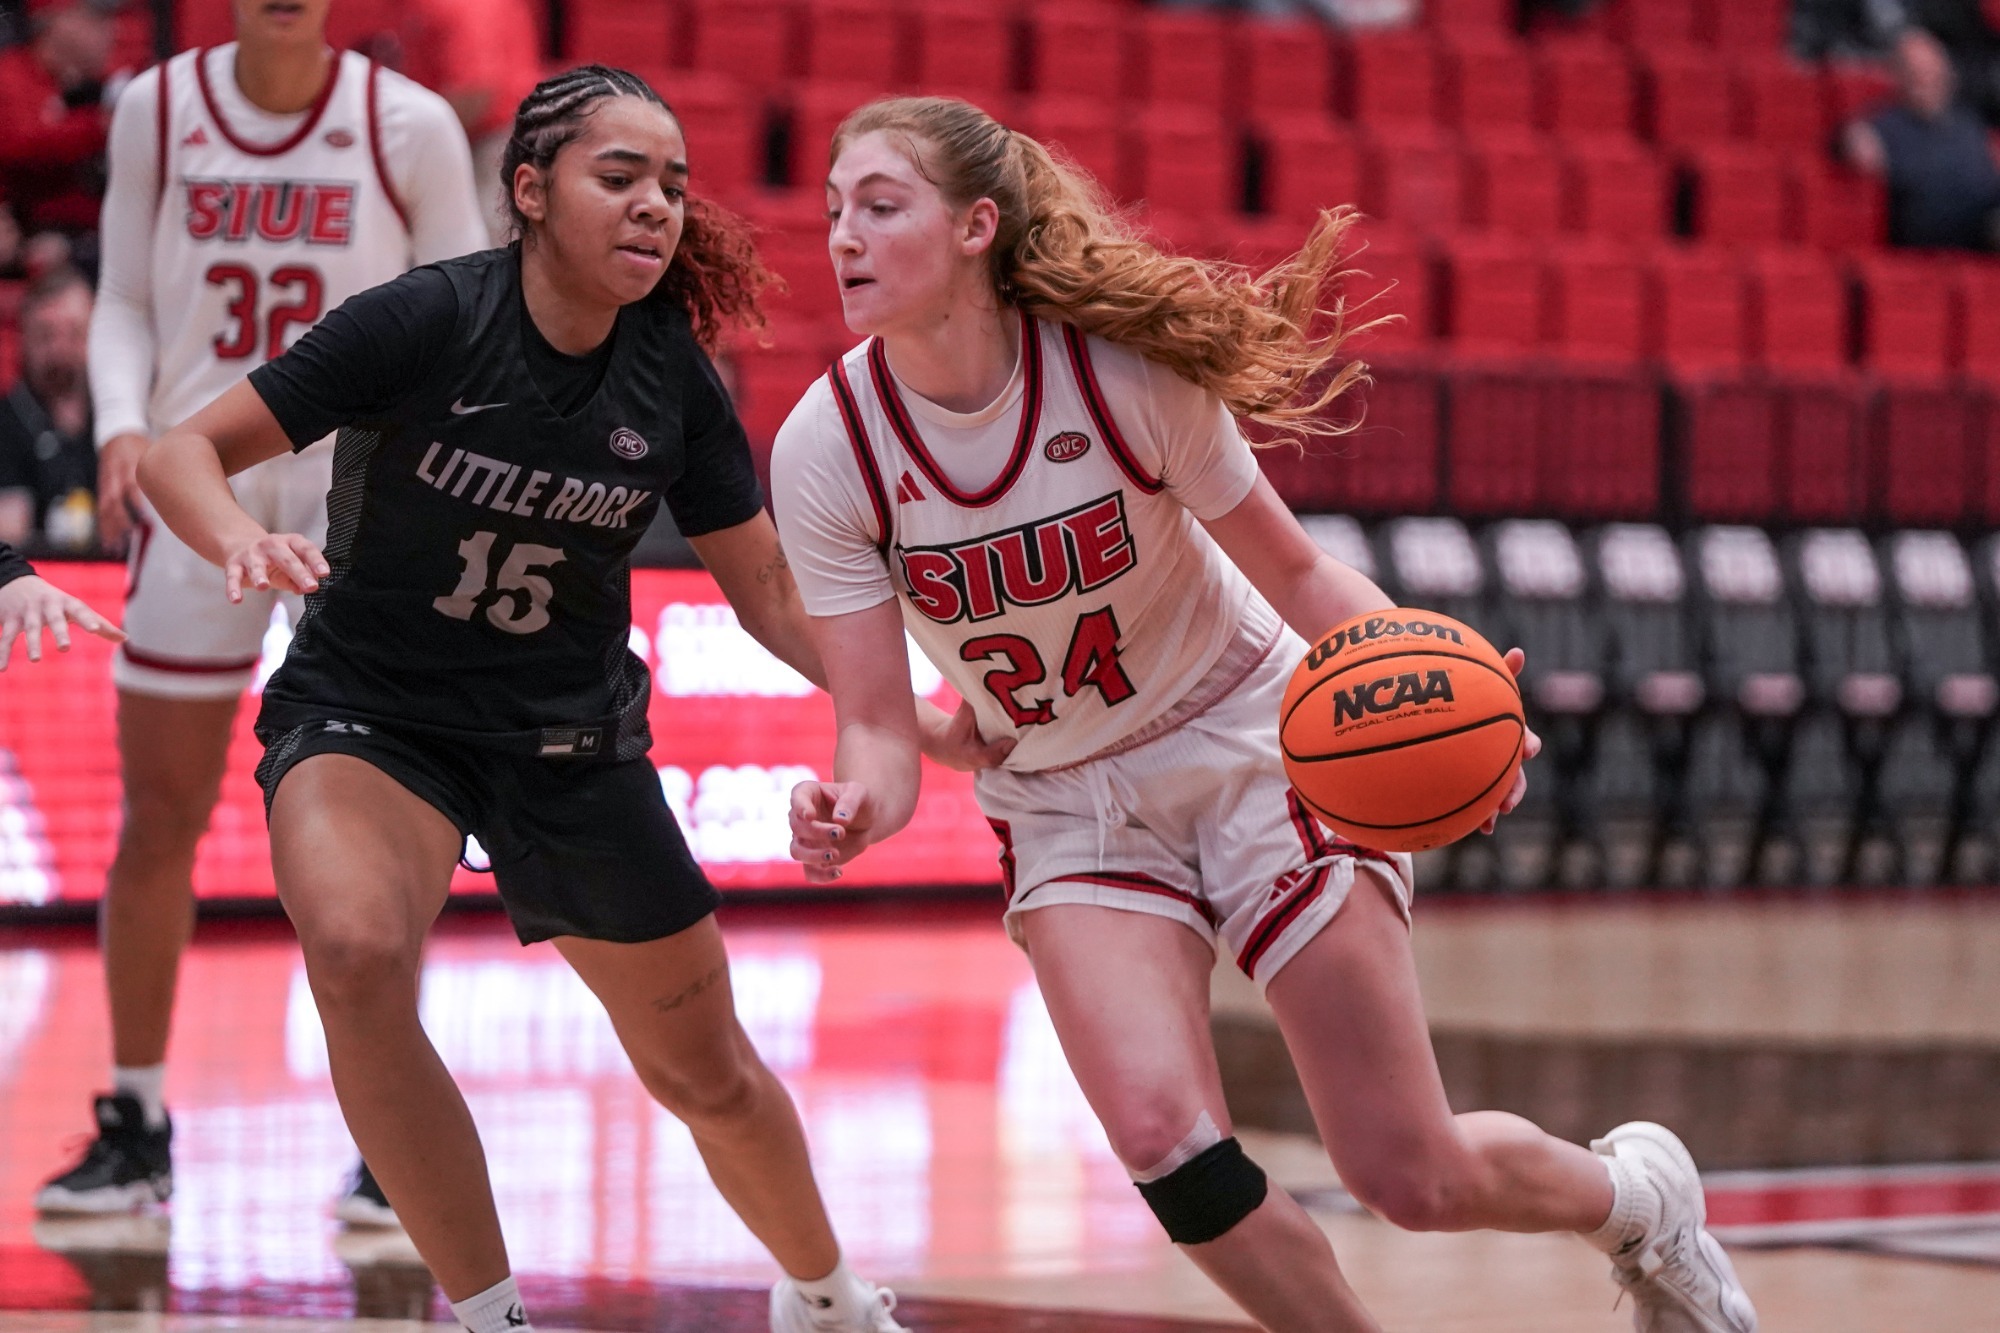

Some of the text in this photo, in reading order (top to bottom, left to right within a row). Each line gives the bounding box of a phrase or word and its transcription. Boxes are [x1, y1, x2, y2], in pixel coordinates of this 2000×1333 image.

[184, 177, 358, 244] SIUE
[206, 263, 323, 361] 32
[617, 436, 638, 451] OVC
[1052, 438, 1081, 457] OVC
[416, 441, 652, 529] LITTLE ROCK
[432, 530, 568, 635] 15
[895, 489, 1138, 625] SIUE
[959, 604, 1138, 729] 24
[1305, 617, 1464, 671] Wilson
[1333, 669, 1455, 727] NCAA
[1335, 706, 1456, 737] OFFICIAL GAME BALL
[581, 735, 595, 748] M
